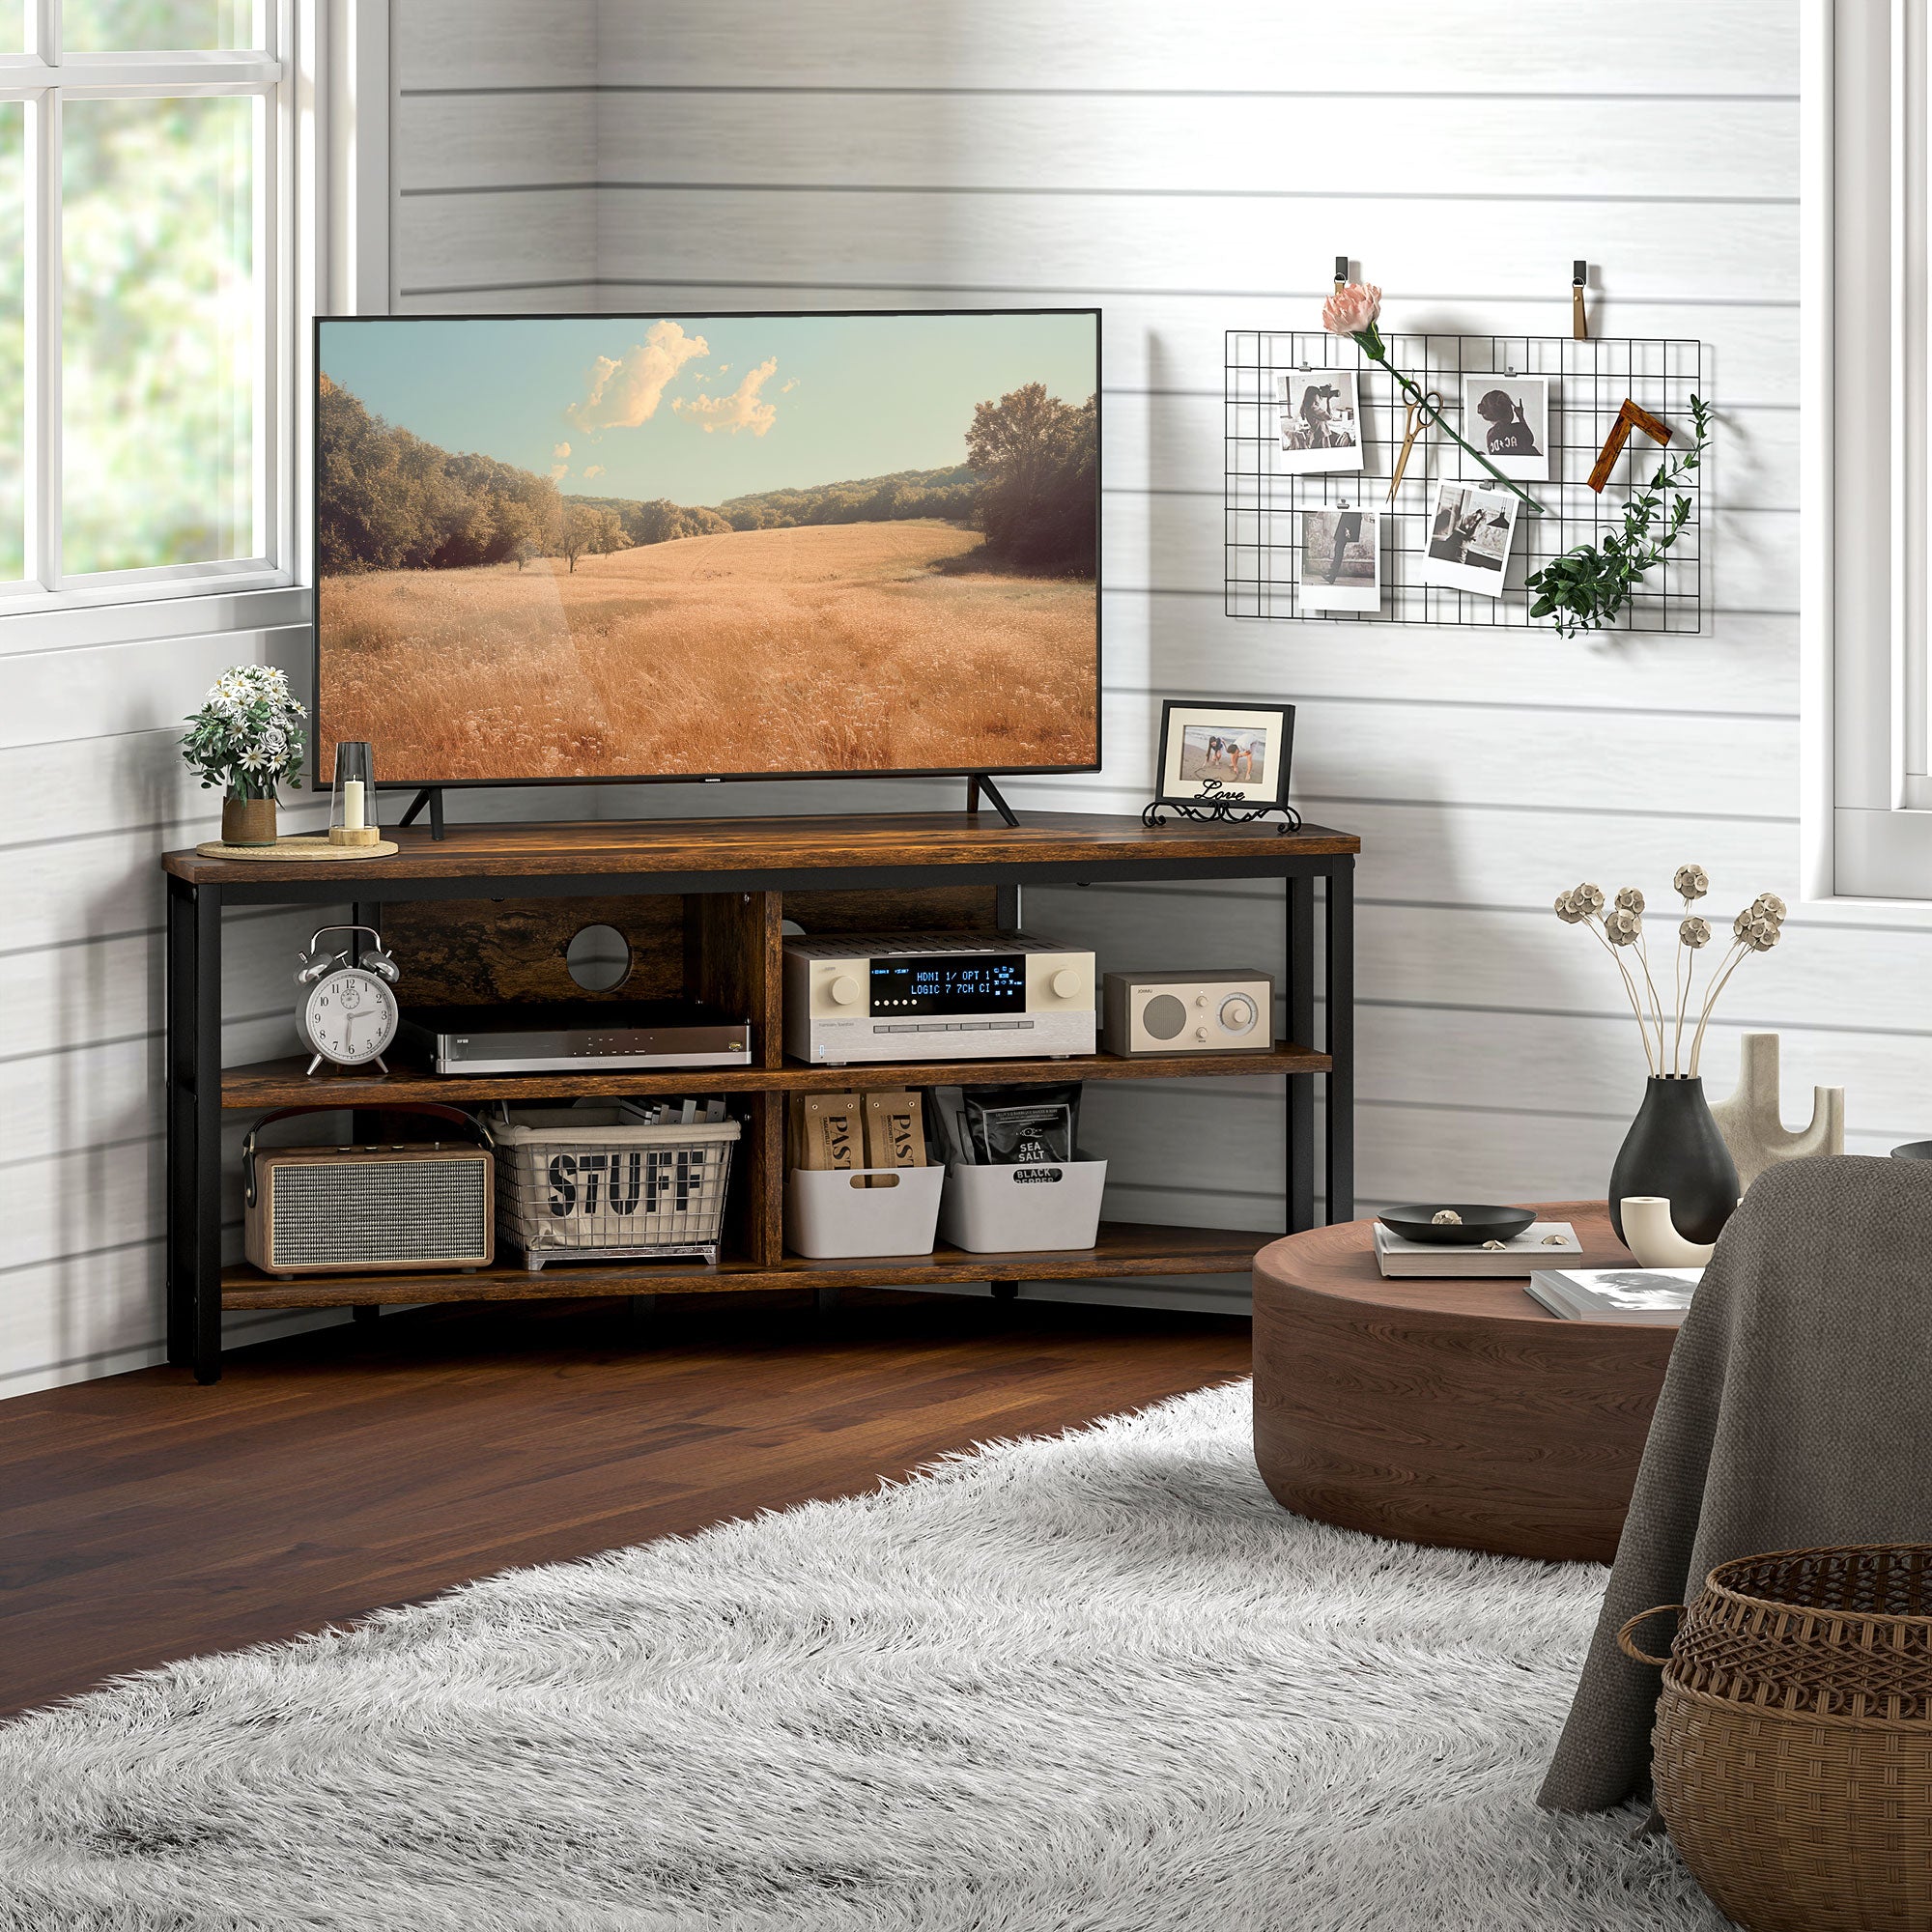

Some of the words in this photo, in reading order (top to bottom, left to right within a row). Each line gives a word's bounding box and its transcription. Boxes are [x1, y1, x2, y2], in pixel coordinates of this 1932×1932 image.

[1194, 779, 1245, 801] Love
[917, 972, 939, 981] HDMI
[962, 971, 980, 980] OPT
[331, 983, 340, 994] 11
[346, 979, 355, 989] 12
[364, 982, 368, 992] 1
[911, 984, 940, 995] LOGIC
[945, 984, 952, 994] 7
[956, 983, 974, 994] 7CH
[320, 996, 328, 1007] 10
[376, 993, 383, 1004] 2
[314, 1014, 321, 1024] 9
[381, 1010, 387, 1020] 3
[320, 1030, 327, 1040] 8
[376, 1027, 383, 1037] 4
[332, 1041, 339, 1051] 7
[348, 1044, 355, 1054] 6
[366, 1039, 373, 1049] 5
[1019, 1141, 1041, 1152] SEA
[1018, 1150, 1044, 1162] SALT
[1016, 1168, 1051, 1179] BLACK
[548, 1151, 703, 1217] STUFF
